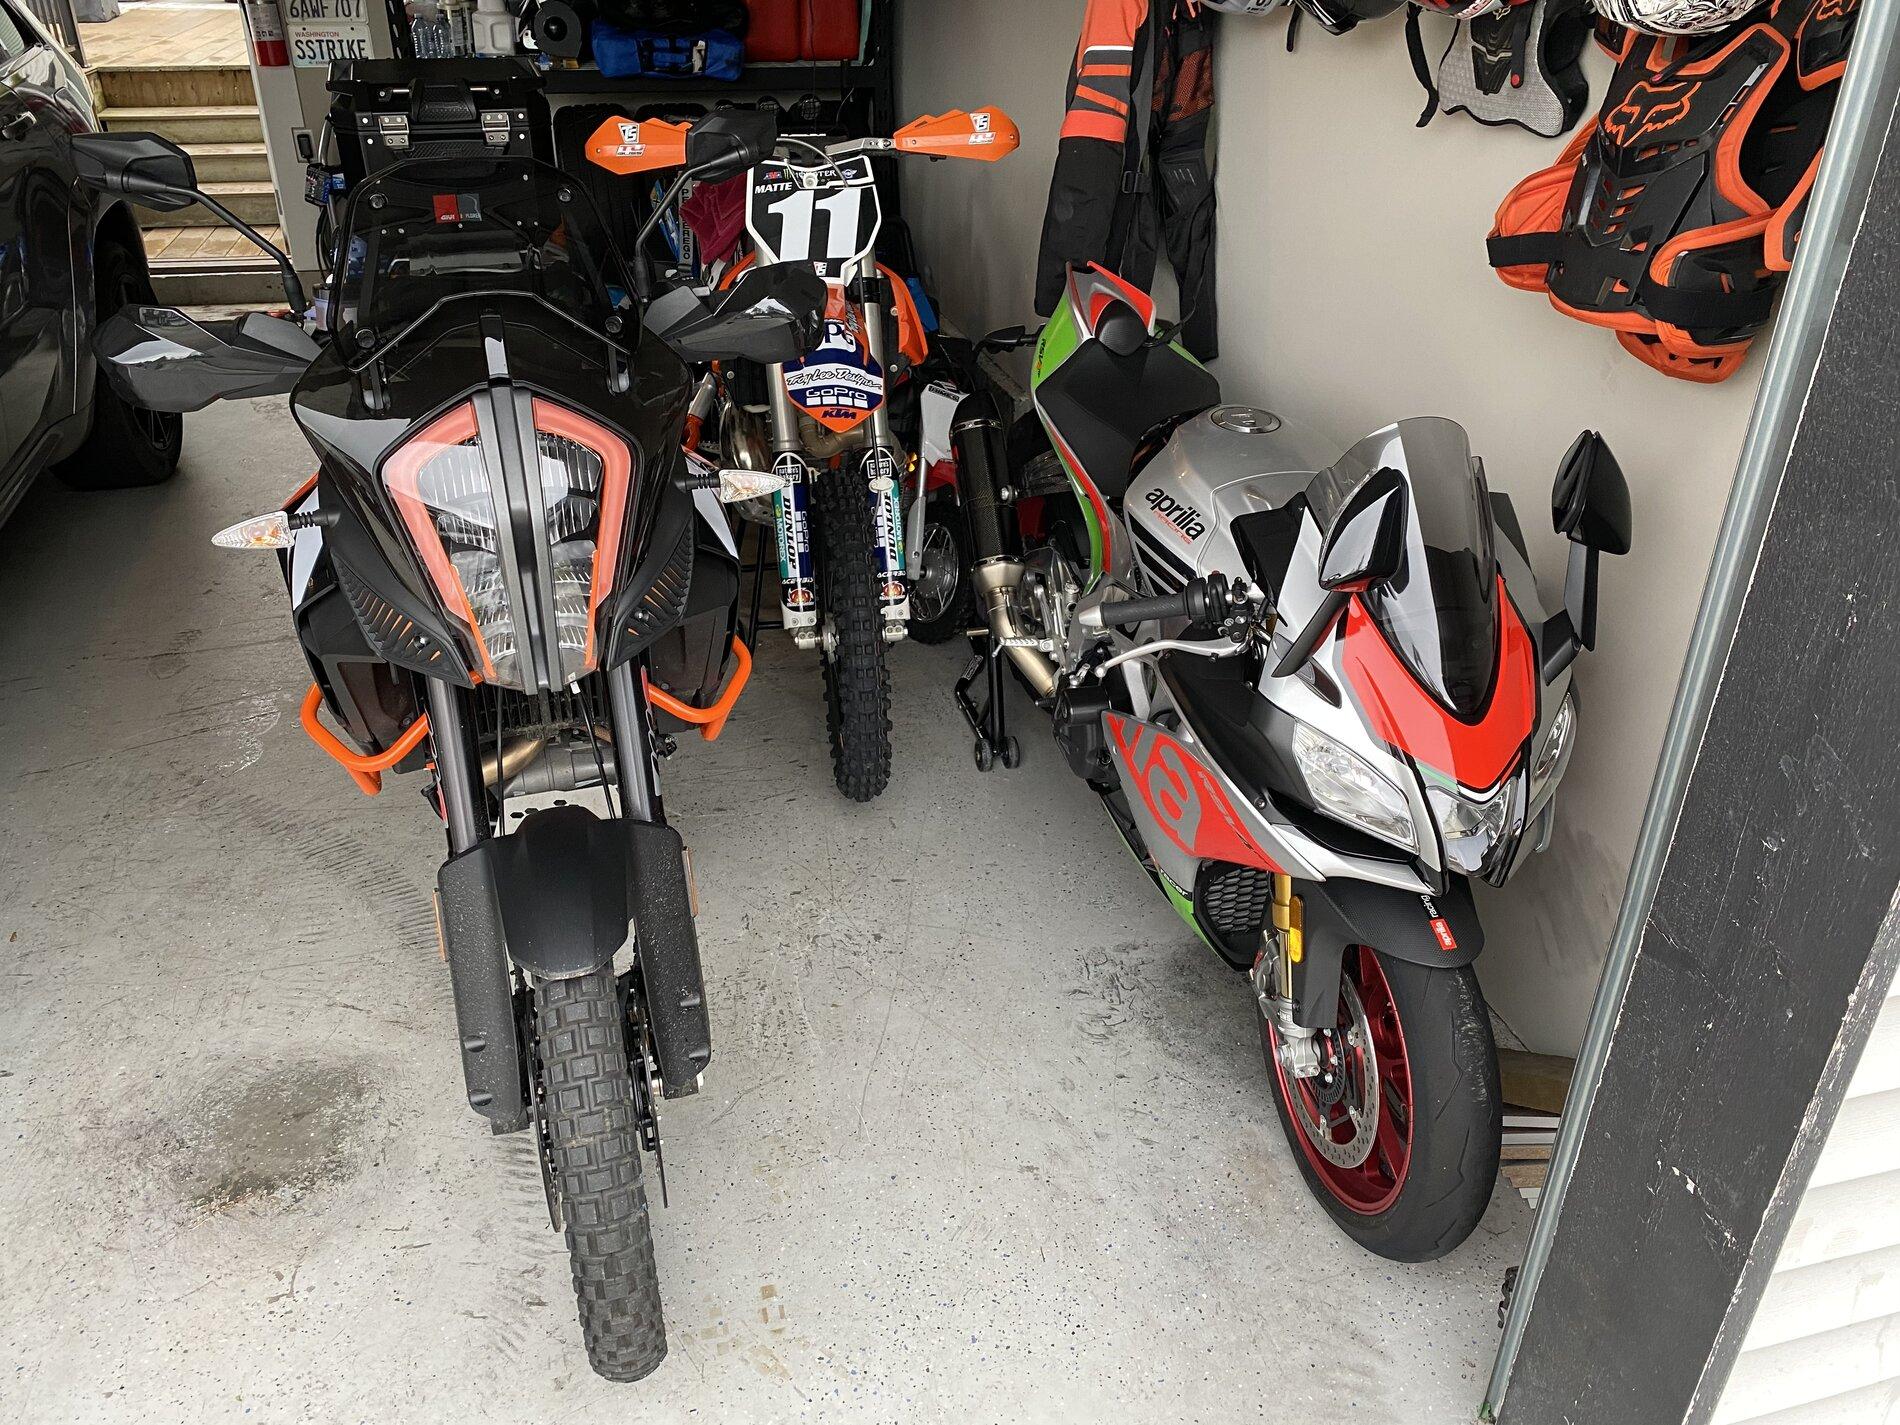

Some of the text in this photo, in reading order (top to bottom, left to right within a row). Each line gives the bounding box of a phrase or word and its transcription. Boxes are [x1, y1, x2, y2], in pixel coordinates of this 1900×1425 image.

[295, 39, 368, 60] SSTRIKE
[755, 181, 793, 194] MATTE
[767, 187, 862, 262] 11
[806, 387, 867, 400] GoPro
[810, 368, 835, 382] Lee
[835, 367, 883, 390] Designs
[821, 408, 857, 420] KTM
[783, 495, 797, 570] DUNLOP
[801, 511, 810, 553] GoPro
[893, 496, 903, 542] MOTOREX
[1145, 487, 1206, 541] aprilia
[776, 517, 787, 563] MOTOREX
